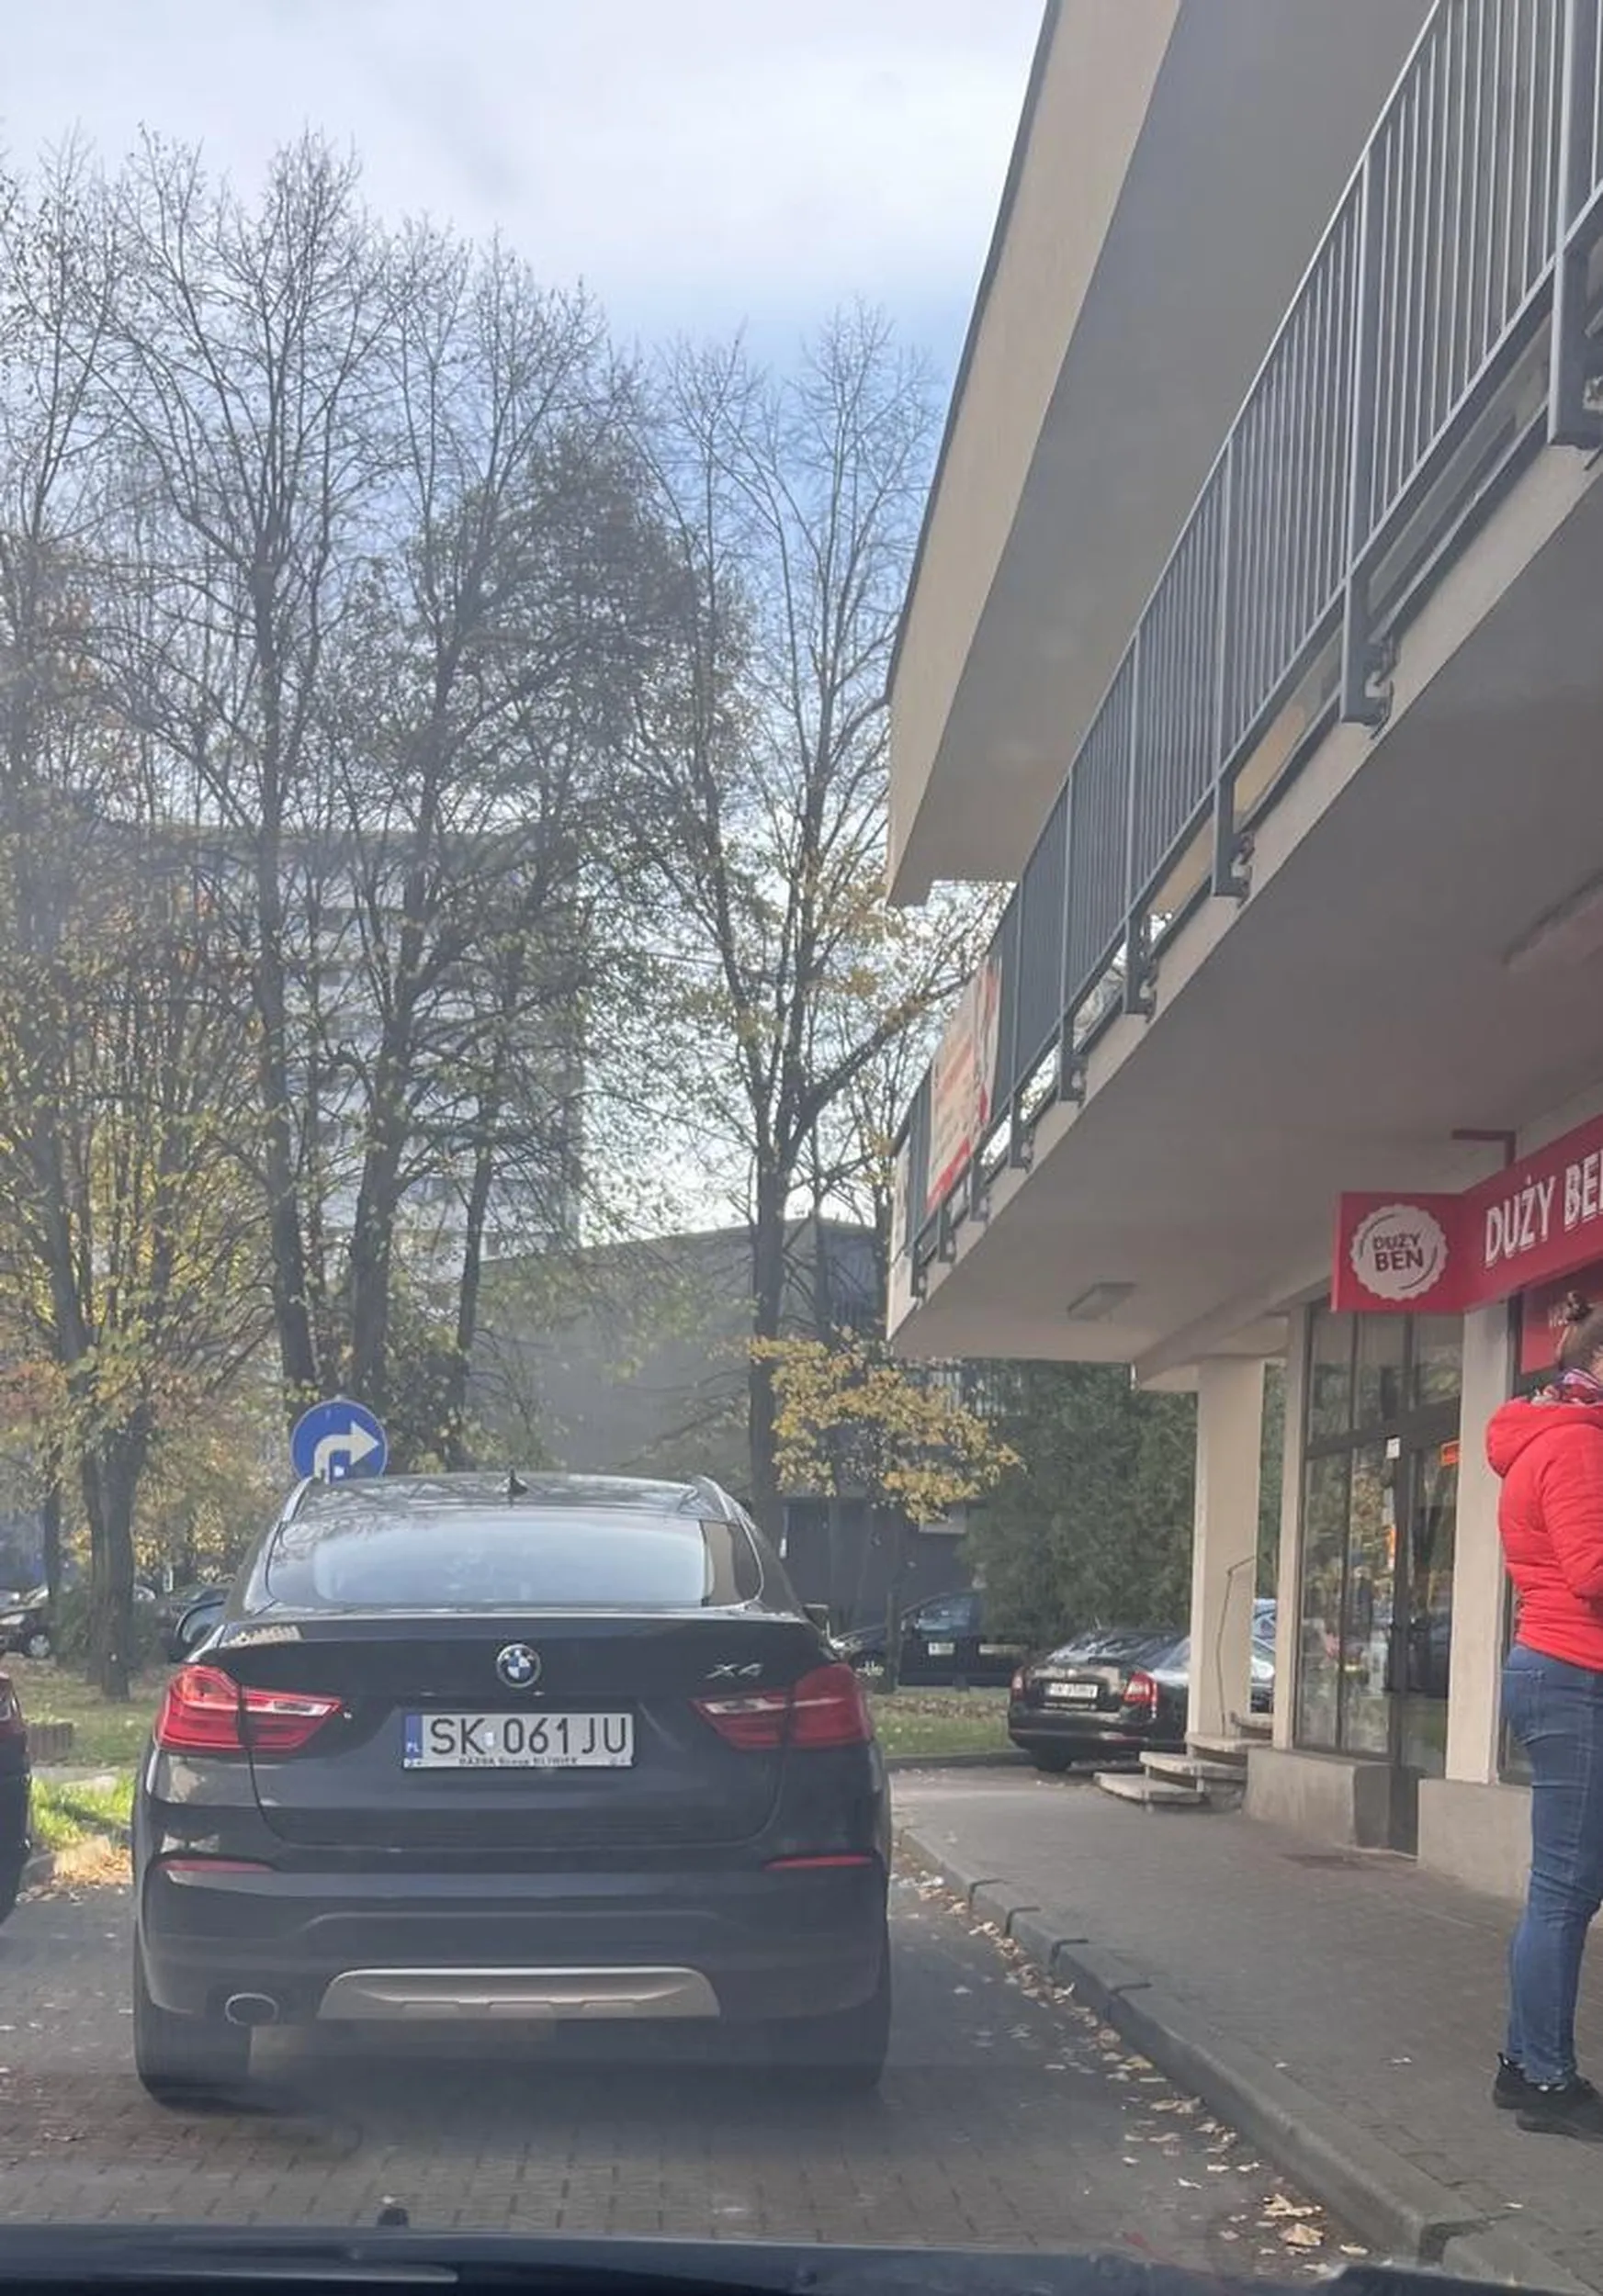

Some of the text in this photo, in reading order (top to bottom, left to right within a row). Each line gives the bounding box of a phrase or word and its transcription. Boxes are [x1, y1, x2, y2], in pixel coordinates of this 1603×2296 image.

[1484, 1149, 1603, 1268] DUŻY BE
[1374, 1247, 1423, 1272] BEN
[706, 1662, 763, 1679] X4
[430, 1716, 627, 1755] SK 061JU
